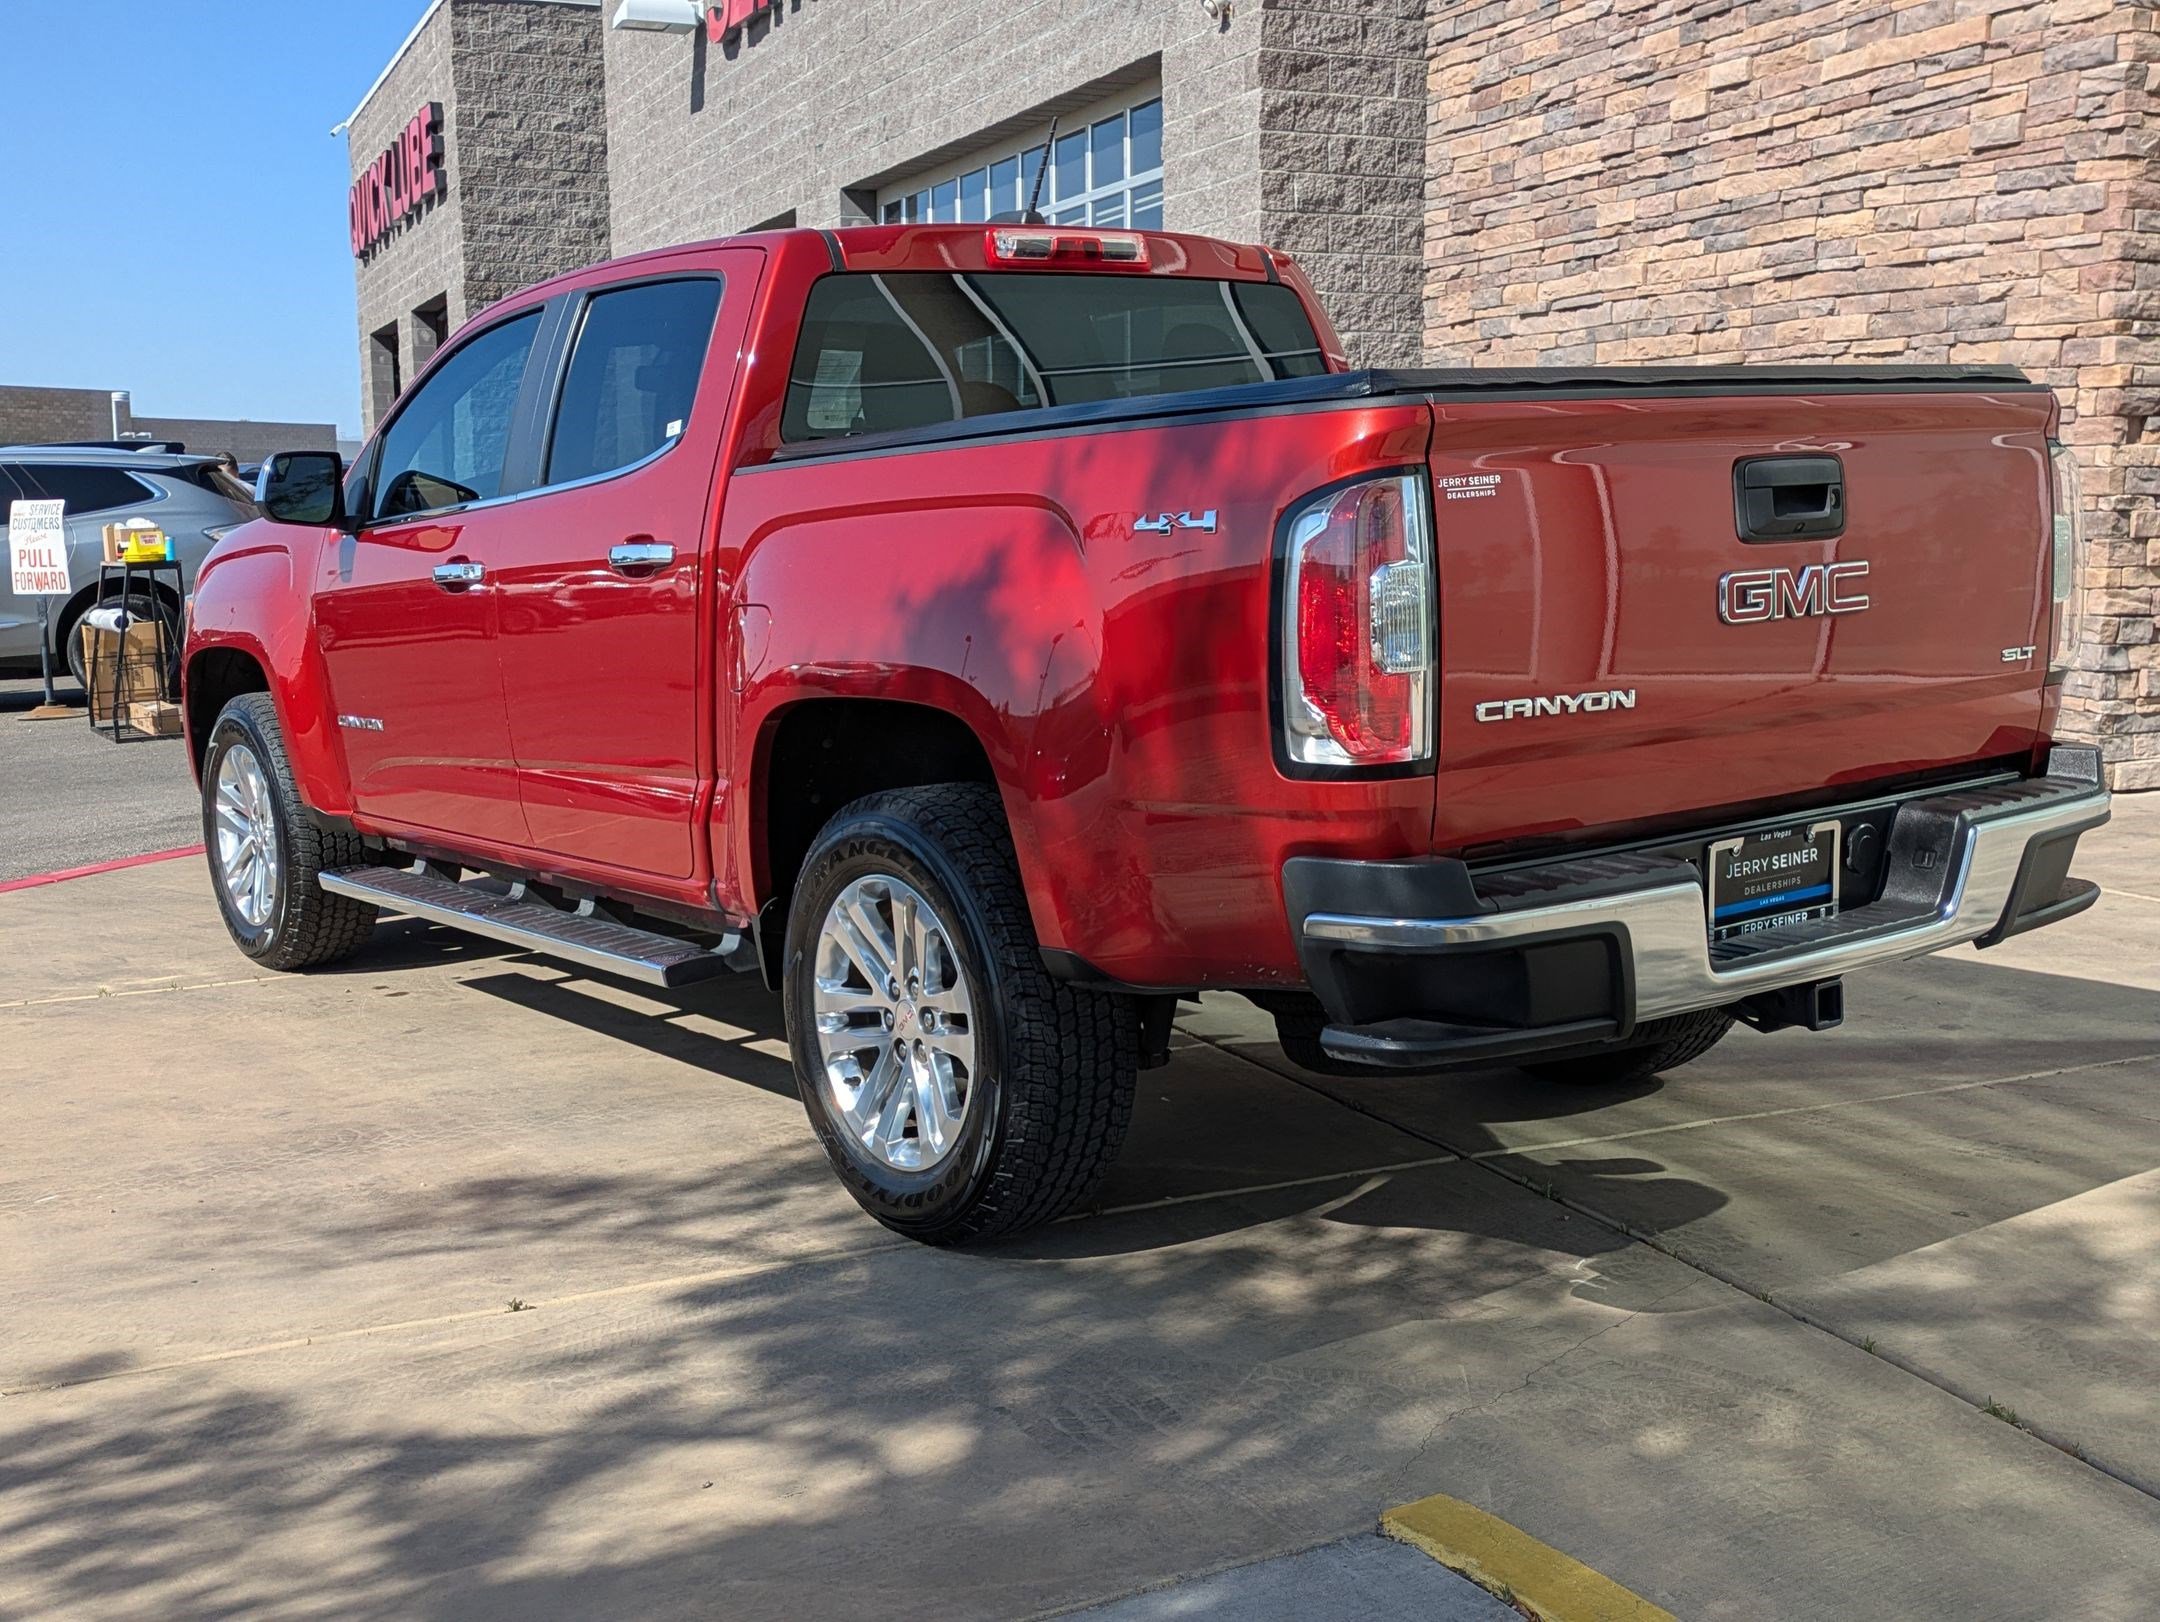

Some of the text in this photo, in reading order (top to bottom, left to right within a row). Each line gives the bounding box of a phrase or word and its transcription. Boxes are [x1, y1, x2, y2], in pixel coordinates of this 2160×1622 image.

[349, 102, 446, 258] QUICK LUBE
[1438, 474, 1502, 488] JERRY SEINER
[1446, 489, 1496, 500] DEALERSHIPS
[29, 503, 61, 517] SERVICE
[12, 517, 60, 531] CUSTOMERS
[18, 548, 58, 568] PULL
[14, 571, 67, 592] FORWARD
[1718, 560, 1870, 625] GMC
[2001, 645, 2037, 662] SLT
[1475, 689, 1636, 722] CANYON
[1760, 829, 1792, 842] Las Vegas
[1726, 847, 1818, 879] JERRY SEINER
[1744, 876, 1801, 896] DEALERSHIPS
